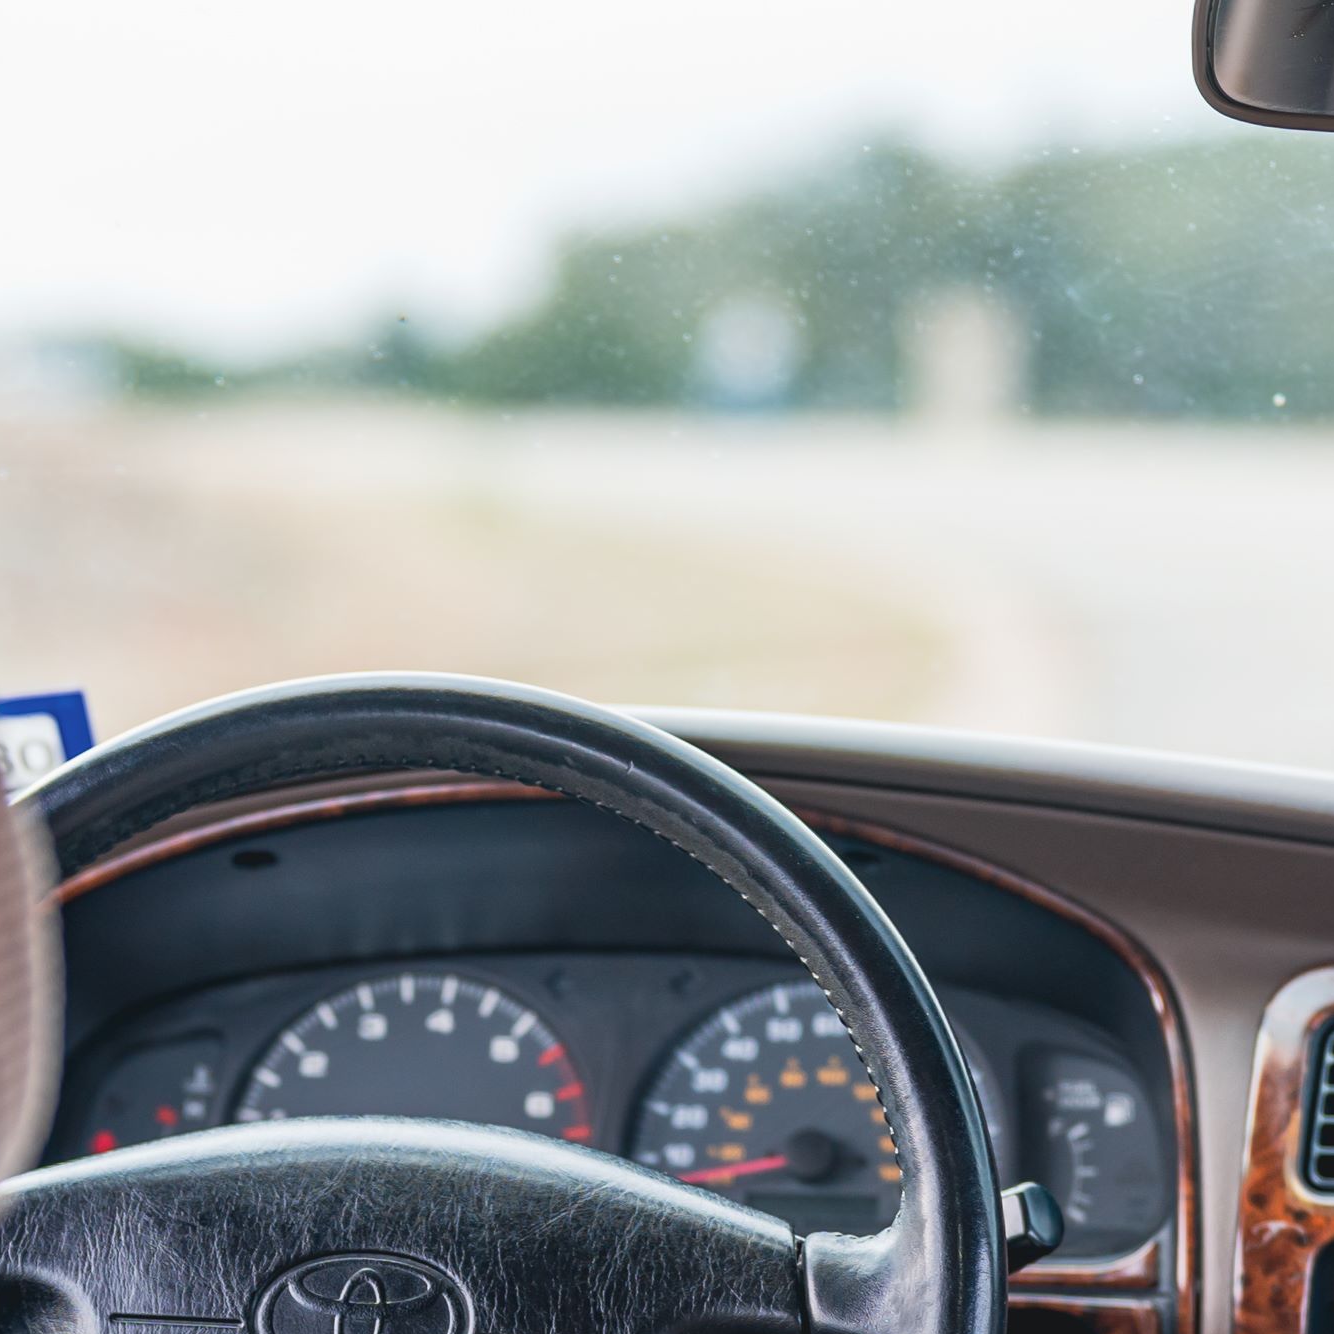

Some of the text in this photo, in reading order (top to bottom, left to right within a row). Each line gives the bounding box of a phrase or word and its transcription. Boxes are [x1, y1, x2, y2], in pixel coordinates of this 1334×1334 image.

[424, 1007, 455, 1034] 4
[722, 1036, 760, 1062] 40
[670, 1104, 709, 1130] 20
[663, 1143, 696, 1168] 10
